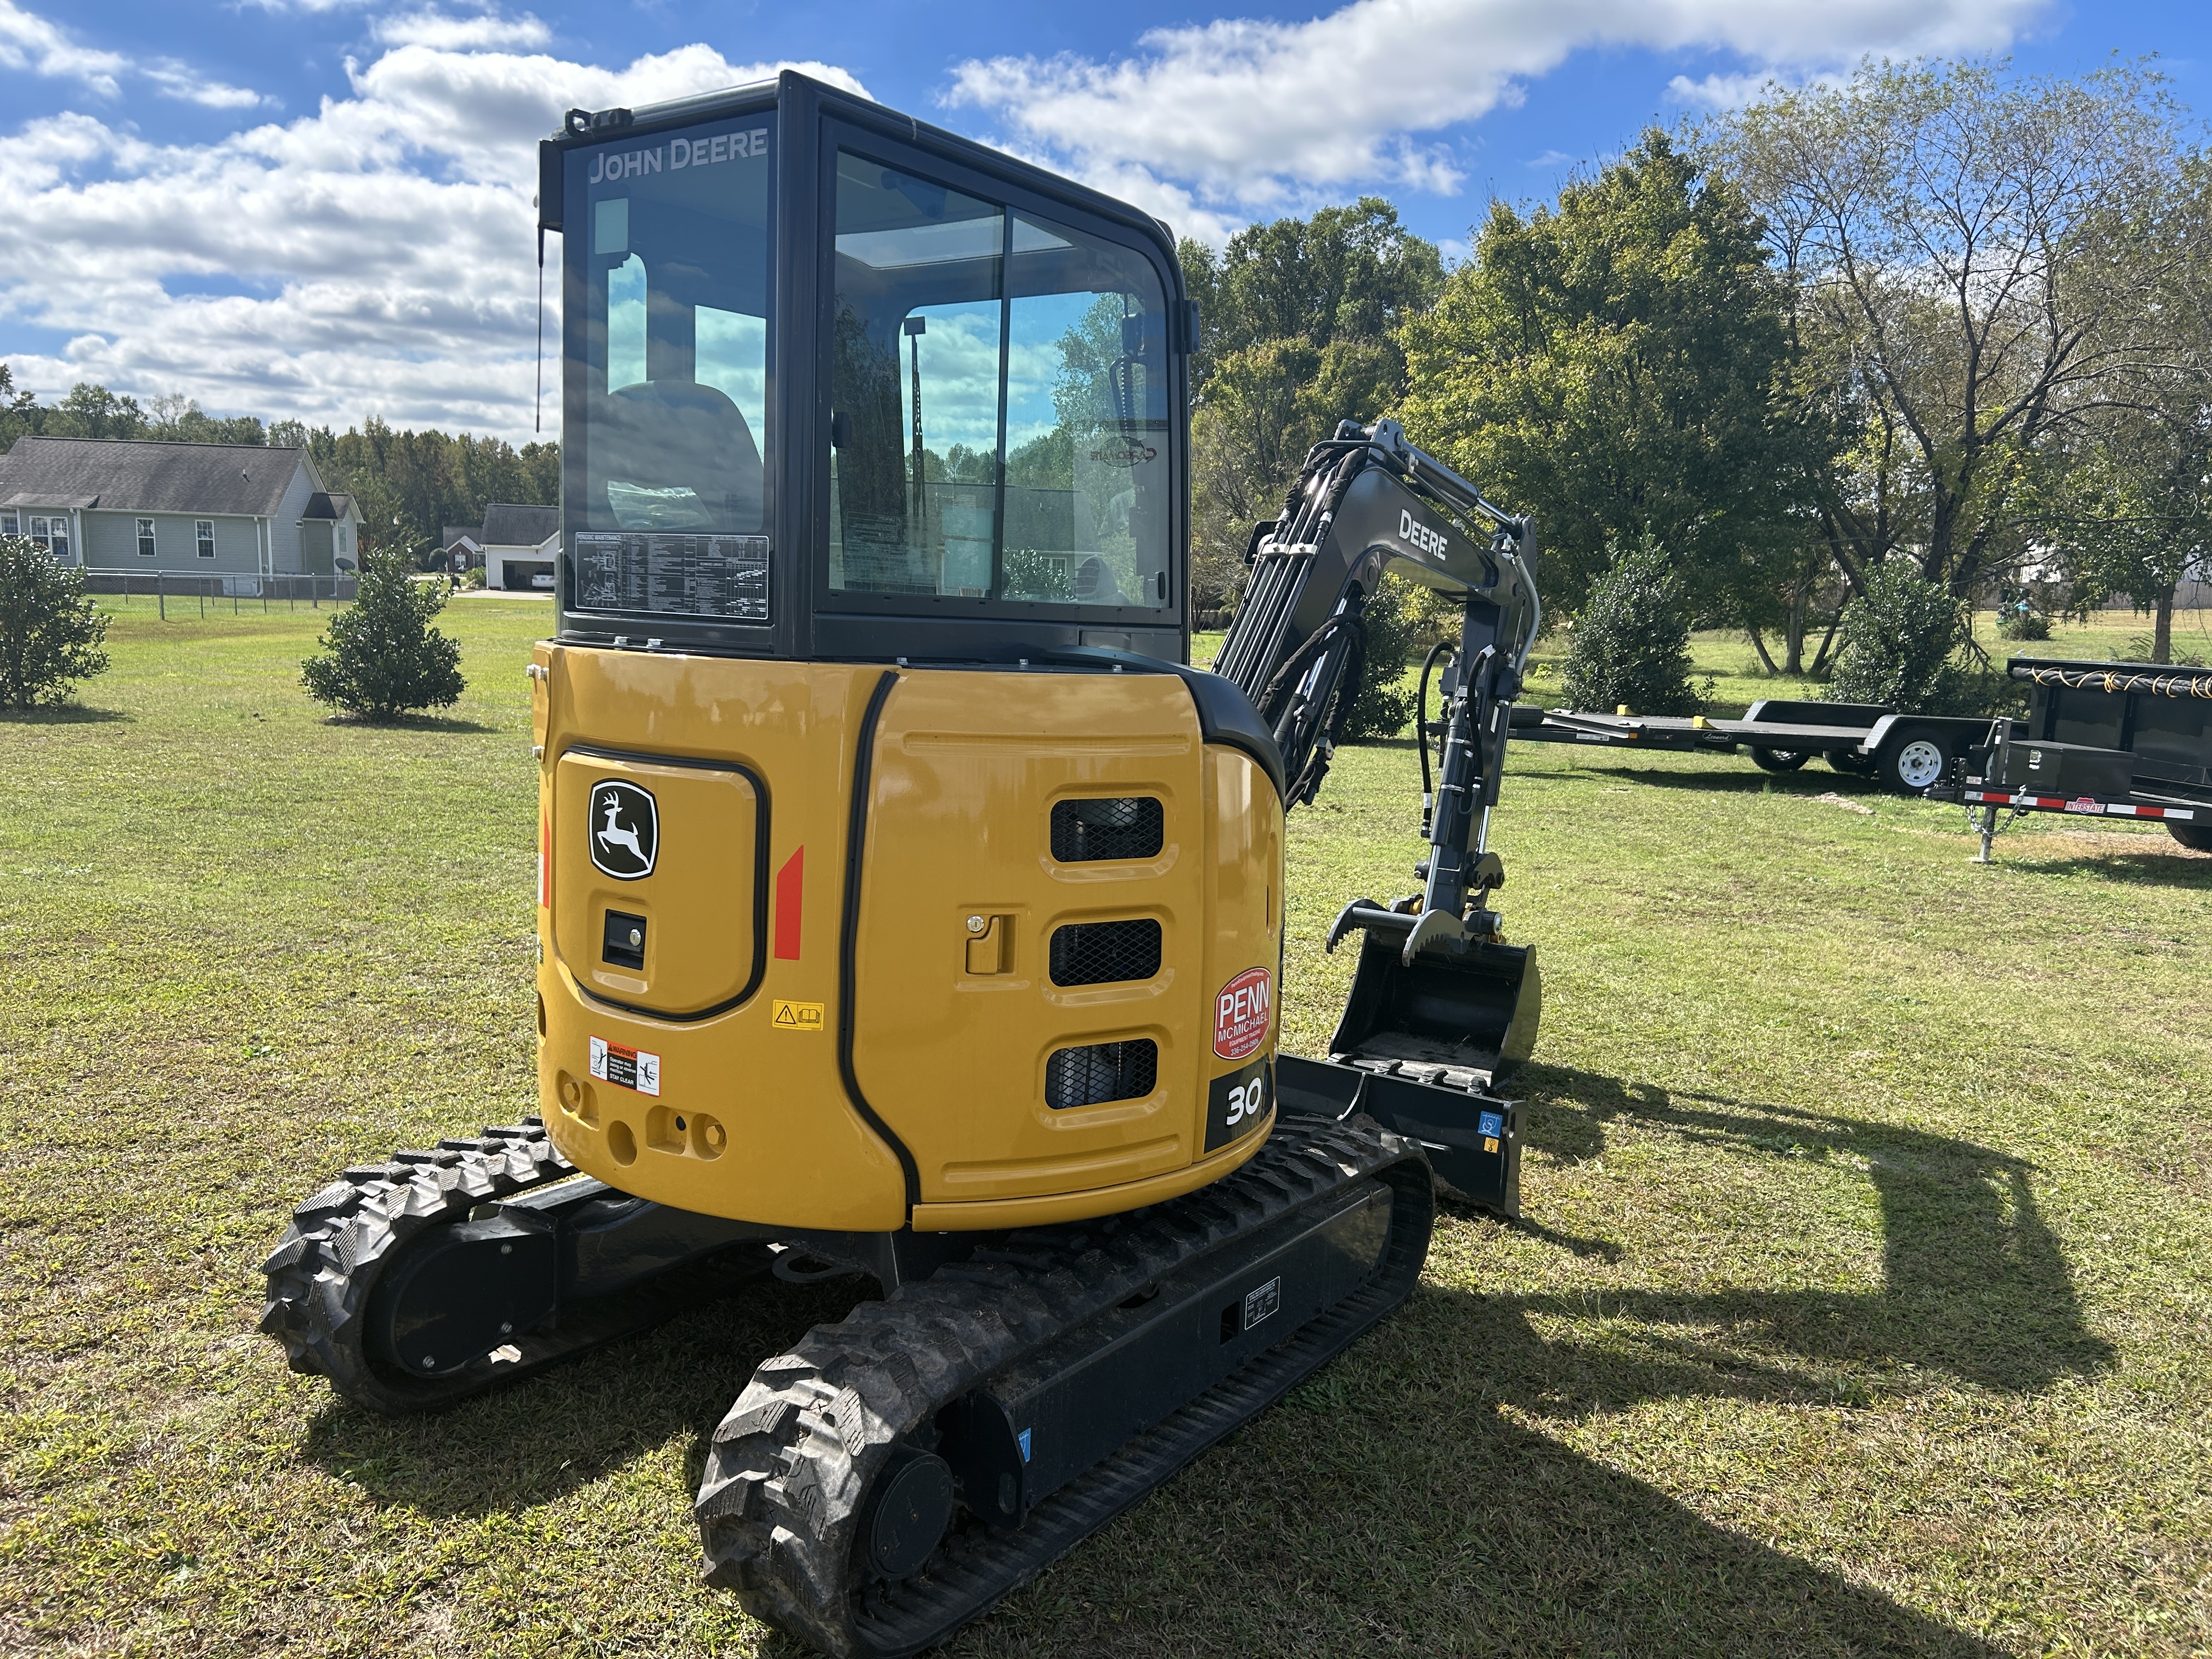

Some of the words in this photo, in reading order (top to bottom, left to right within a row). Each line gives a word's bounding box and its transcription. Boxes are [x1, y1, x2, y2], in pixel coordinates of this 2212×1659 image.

[590, 147, 662, 184] JOHN
[670, 128, 768, 171] DEERE
[1398, 509, 1448, 561] DEERE
[2067, 803, 2103, 812] INTERSTATE
[1217, 1011, 1268, 1043] MCMICHAEL
[1219, 977, 1270, 1029] PENN
[613, 1046, 636, 1058] WARNING
[1227, 1077, 1262, 1125] 30
